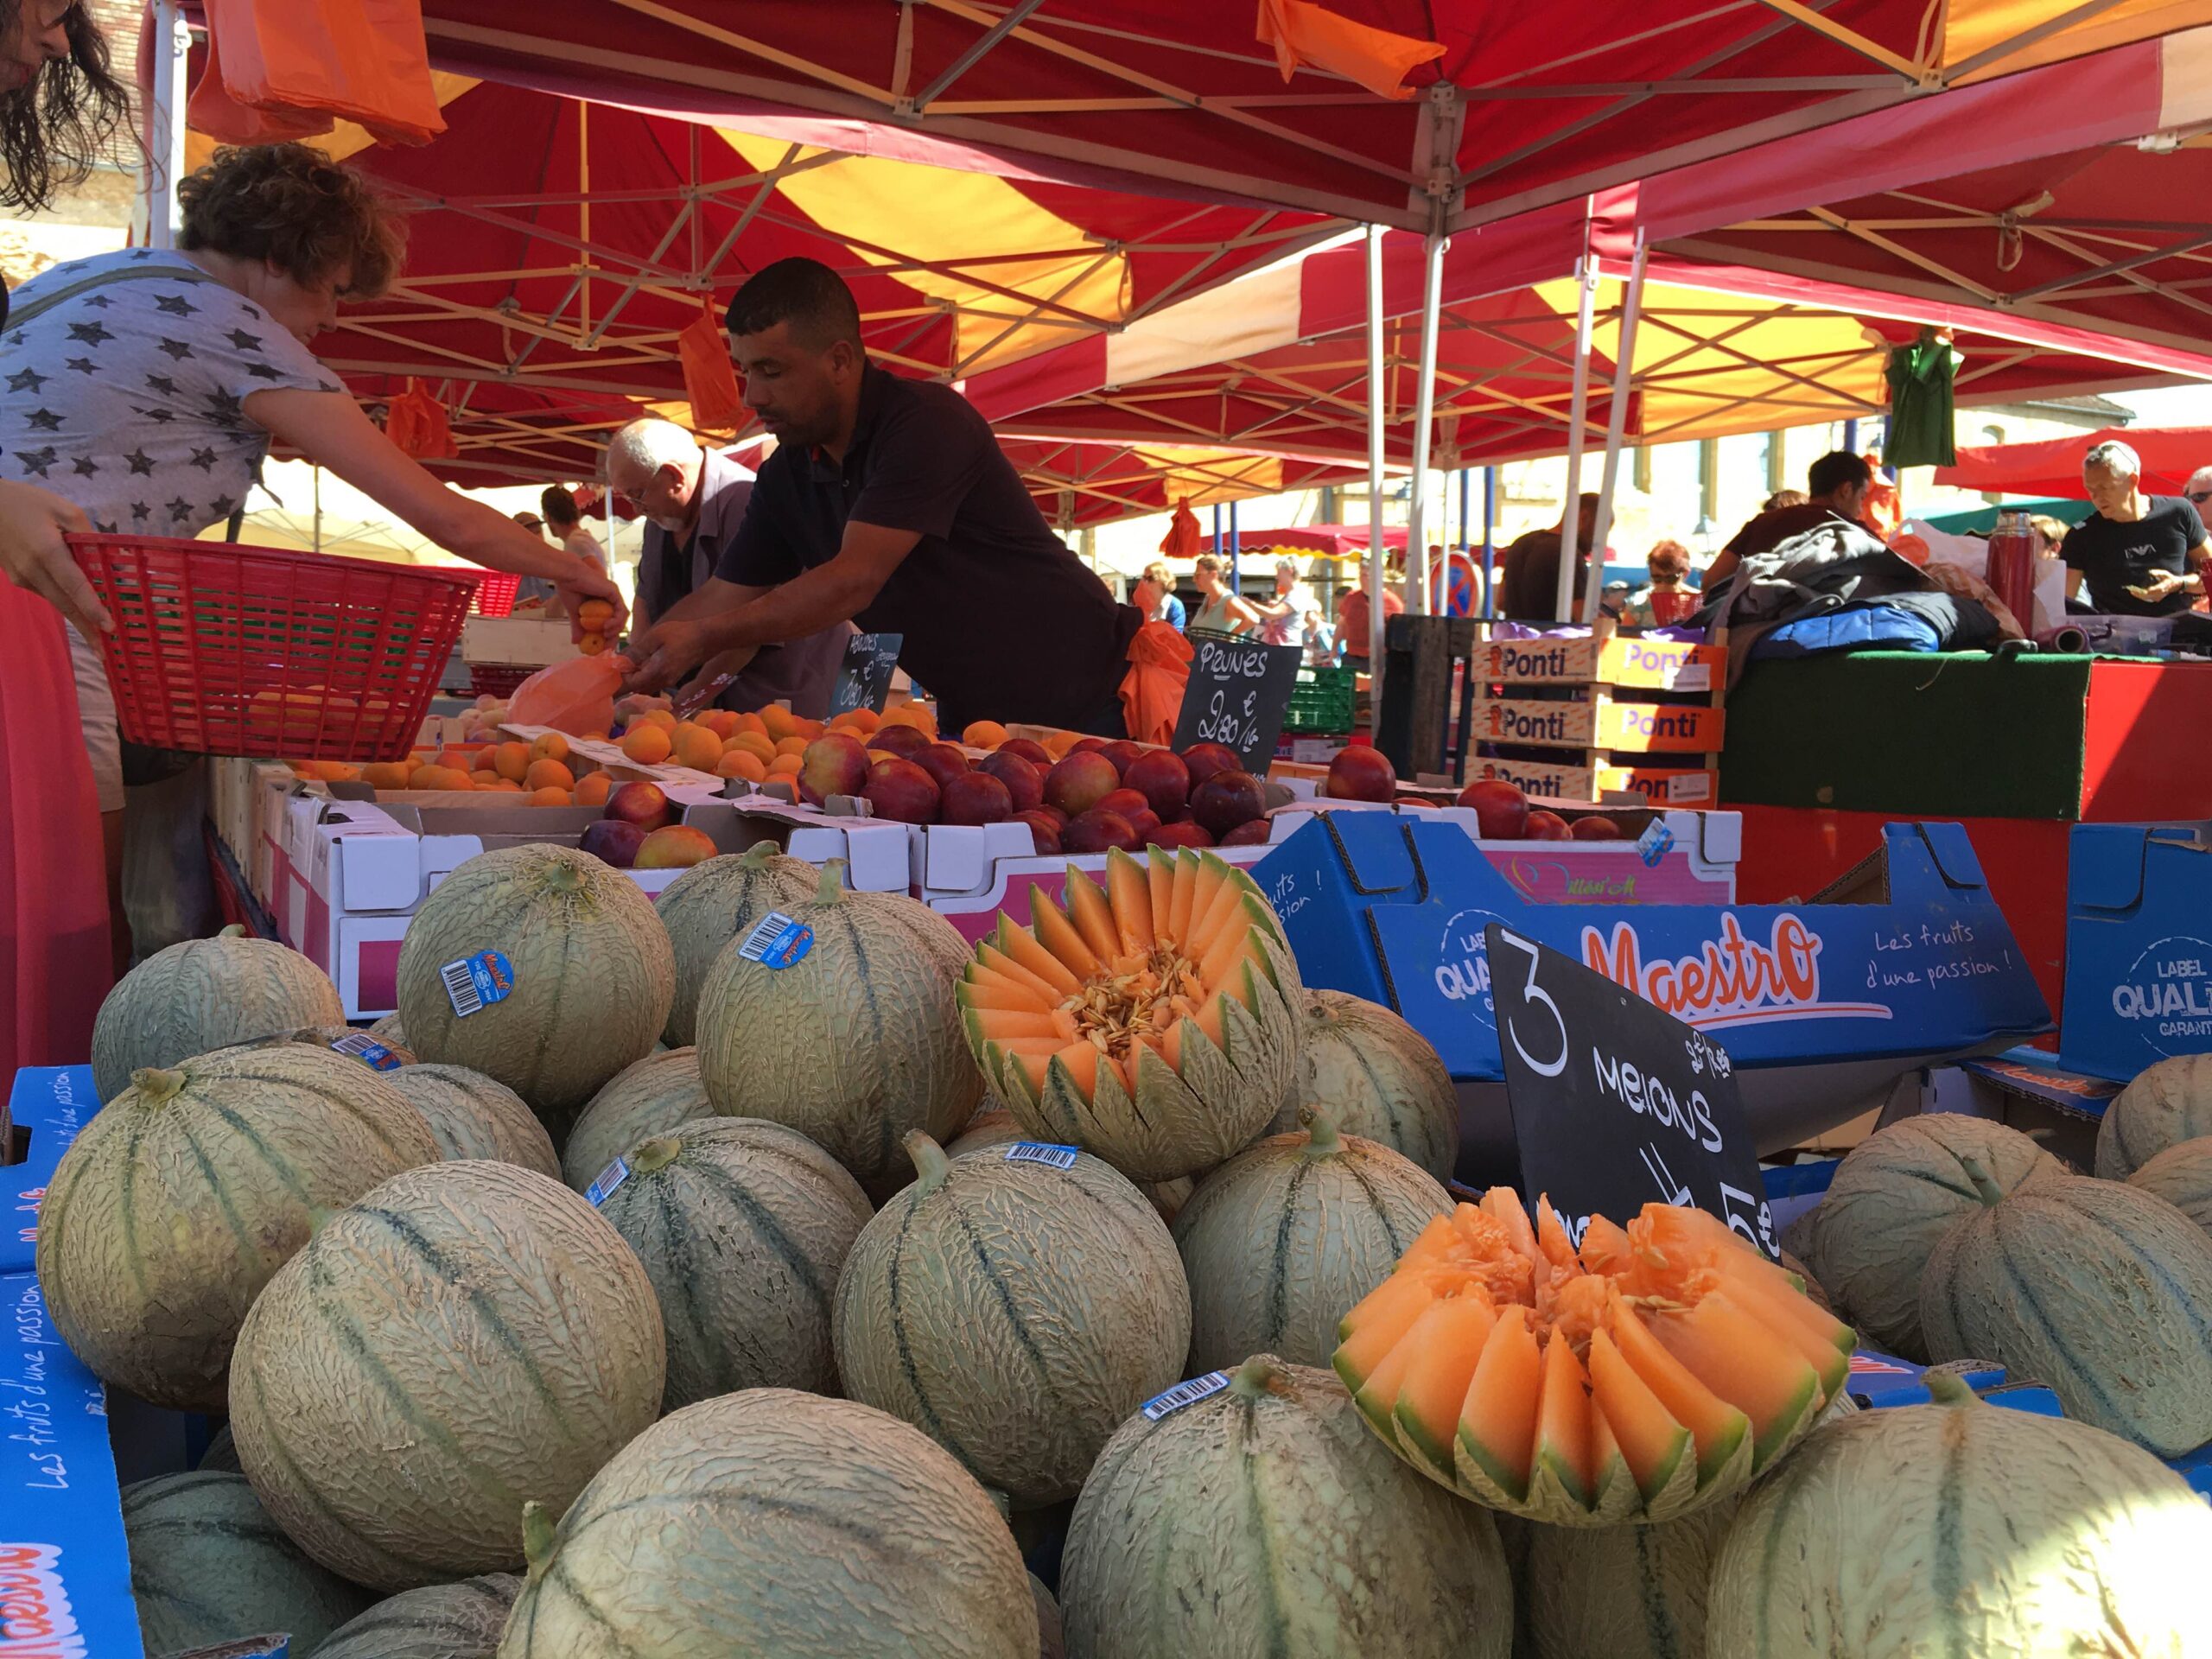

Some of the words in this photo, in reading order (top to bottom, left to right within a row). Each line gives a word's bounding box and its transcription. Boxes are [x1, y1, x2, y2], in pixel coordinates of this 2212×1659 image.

[1503, 647, 1565, 677] Ponti
[1503, 708, 1563, 741] Ponti
[1622, 709, 1696, 737] Ponti
[1874, 931, 1913, 951] Les
[1919, 919, 1974, 946] fruits
[1866, 959, 1922, 988] d'une
[1927, 957, 1999, 990] passion
[2157, 959, 2208, 978] LABEL
[1500, 929, 1568, 1077] 3
[7, 1284, 61, 1345] passion
[25, 1452, 70, 1490] Les
